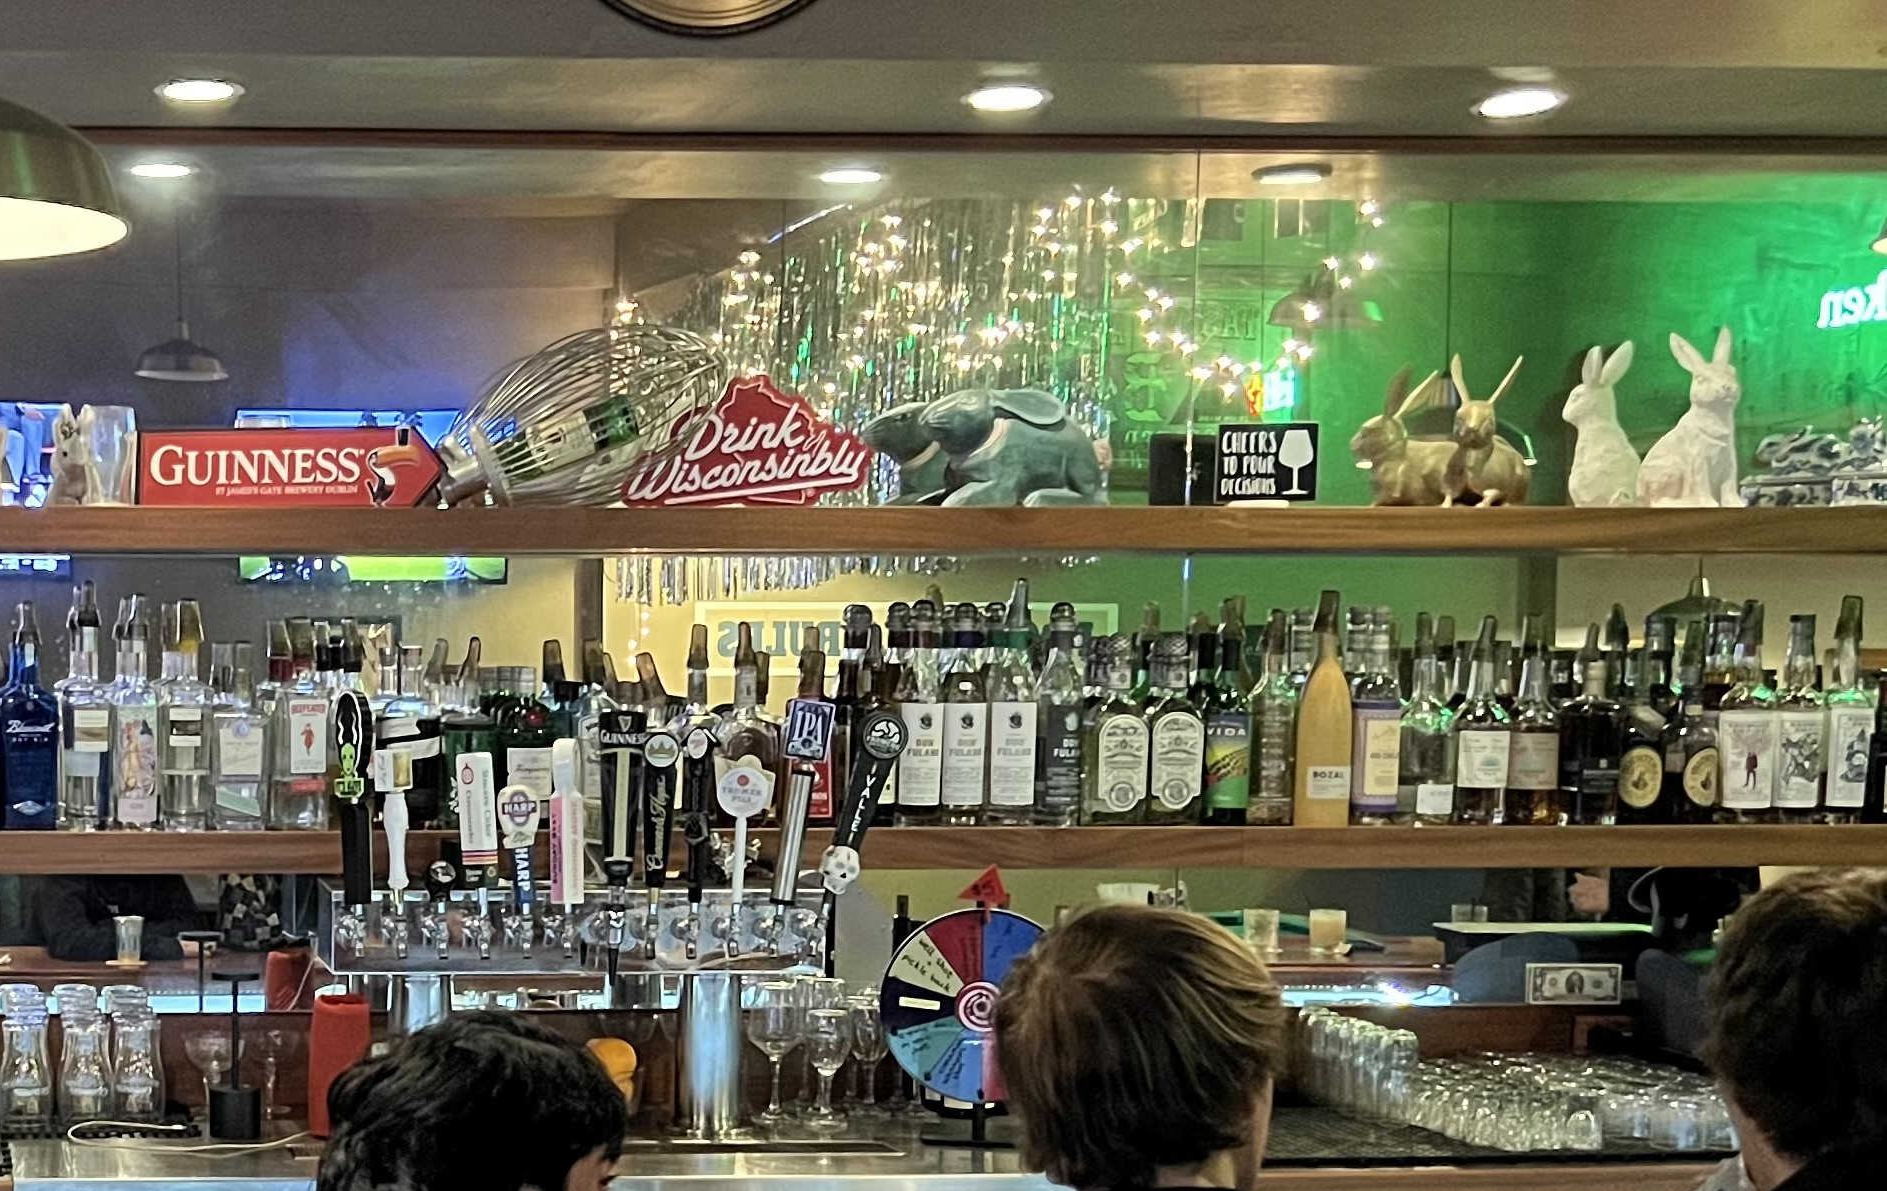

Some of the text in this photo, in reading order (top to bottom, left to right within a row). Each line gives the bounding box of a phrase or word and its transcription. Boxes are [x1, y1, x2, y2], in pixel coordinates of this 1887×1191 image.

[685, 404, 805, 461] Drink
[1222, 431, 1277, 454] CHEERS
[150, 445, 362, 486] GUINNESS
[628, 439, 864, 500] Wisconsinbly
[1222, 456, 1275, 475] TO POUR
[792, 710, 823, 745] IPA
[504, 802, 536, 814] HARP
[515, 847, 531, 892] HARP
